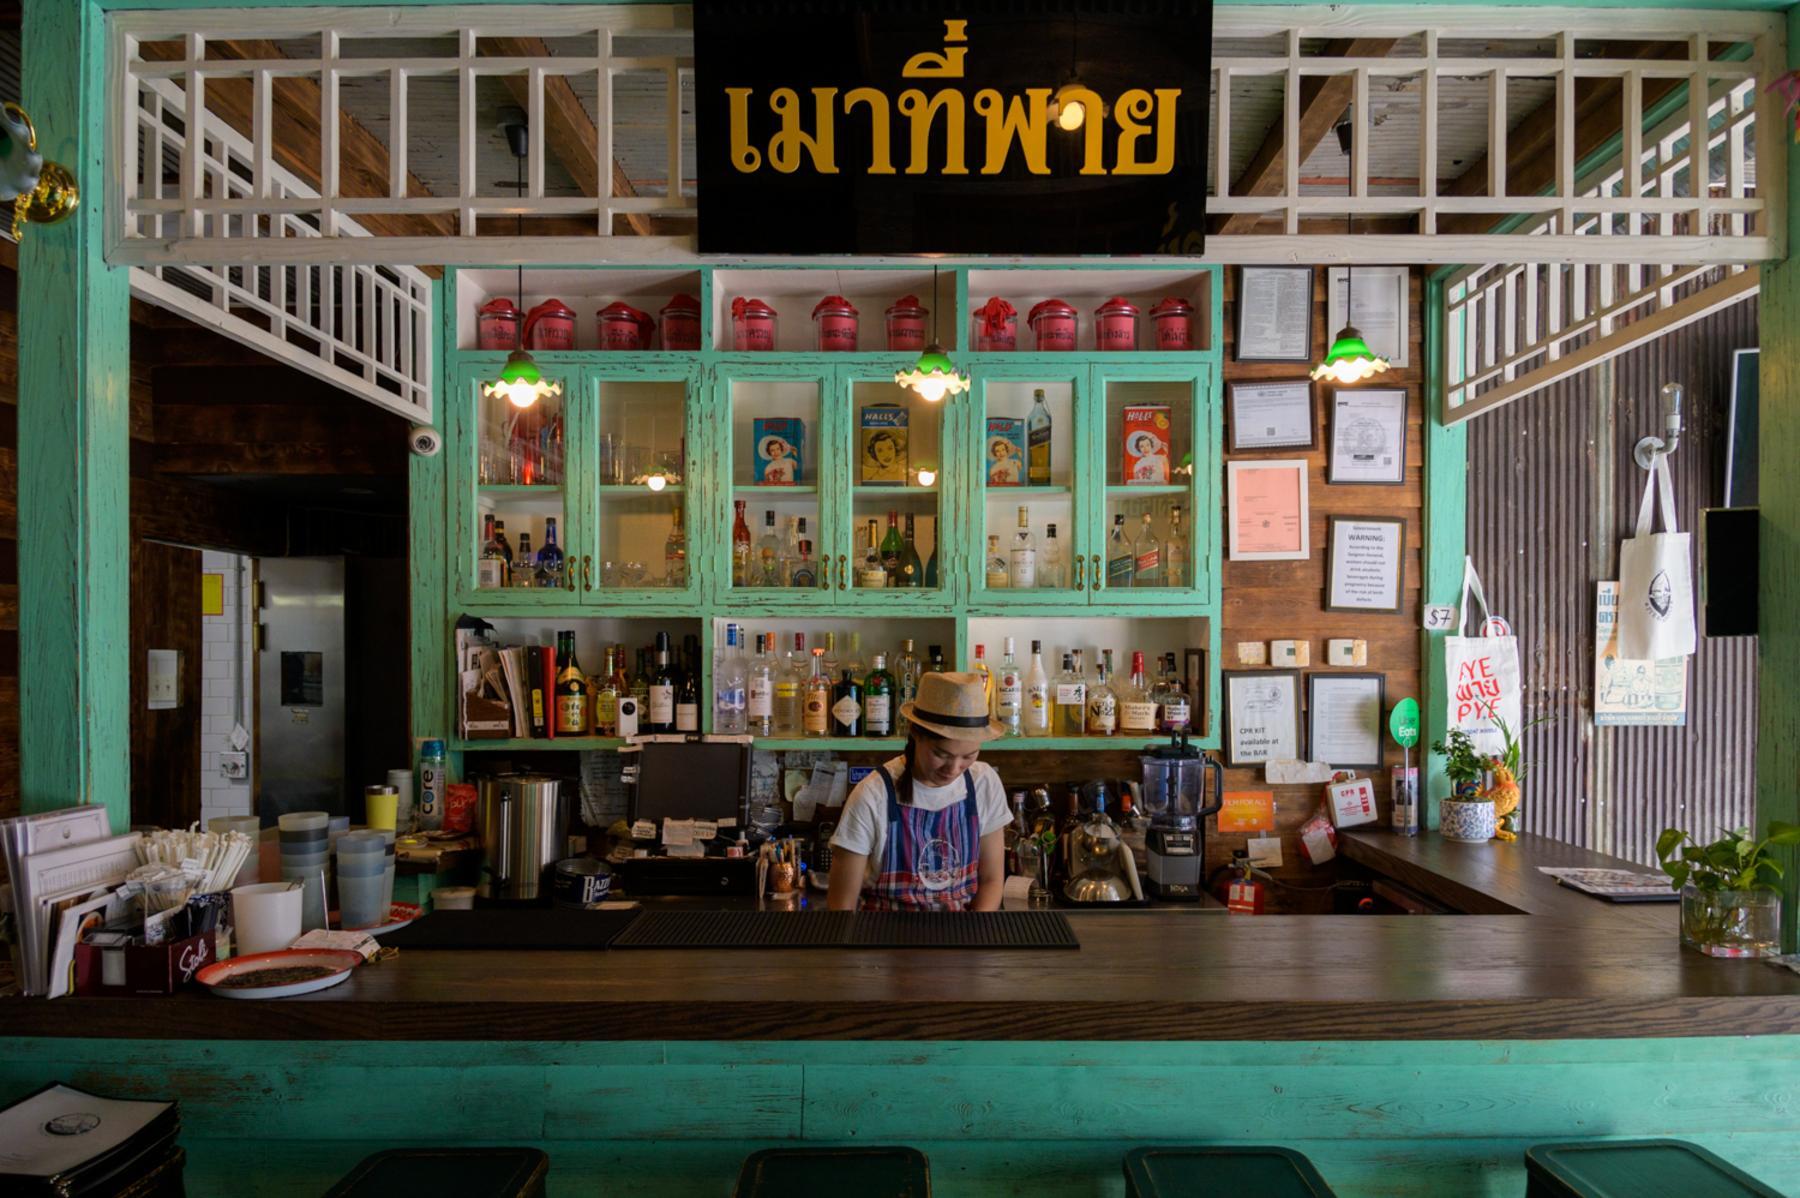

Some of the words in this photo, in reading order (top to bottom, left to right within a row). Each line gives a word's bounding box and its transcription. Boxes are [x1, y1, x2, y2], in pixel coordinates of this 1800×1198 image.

[724, 18, 1183, 176] เมาที่พาย
[864, 412, 895, 421] HALLS
[1126, 410, 1153, 422] HALLS
[1348, 533, 1386, 543] WARNING:
[1398, 727, 1416, 737] Eats
[1240, 737, 1271, 746] available
[421, 769, 434, 815] core
